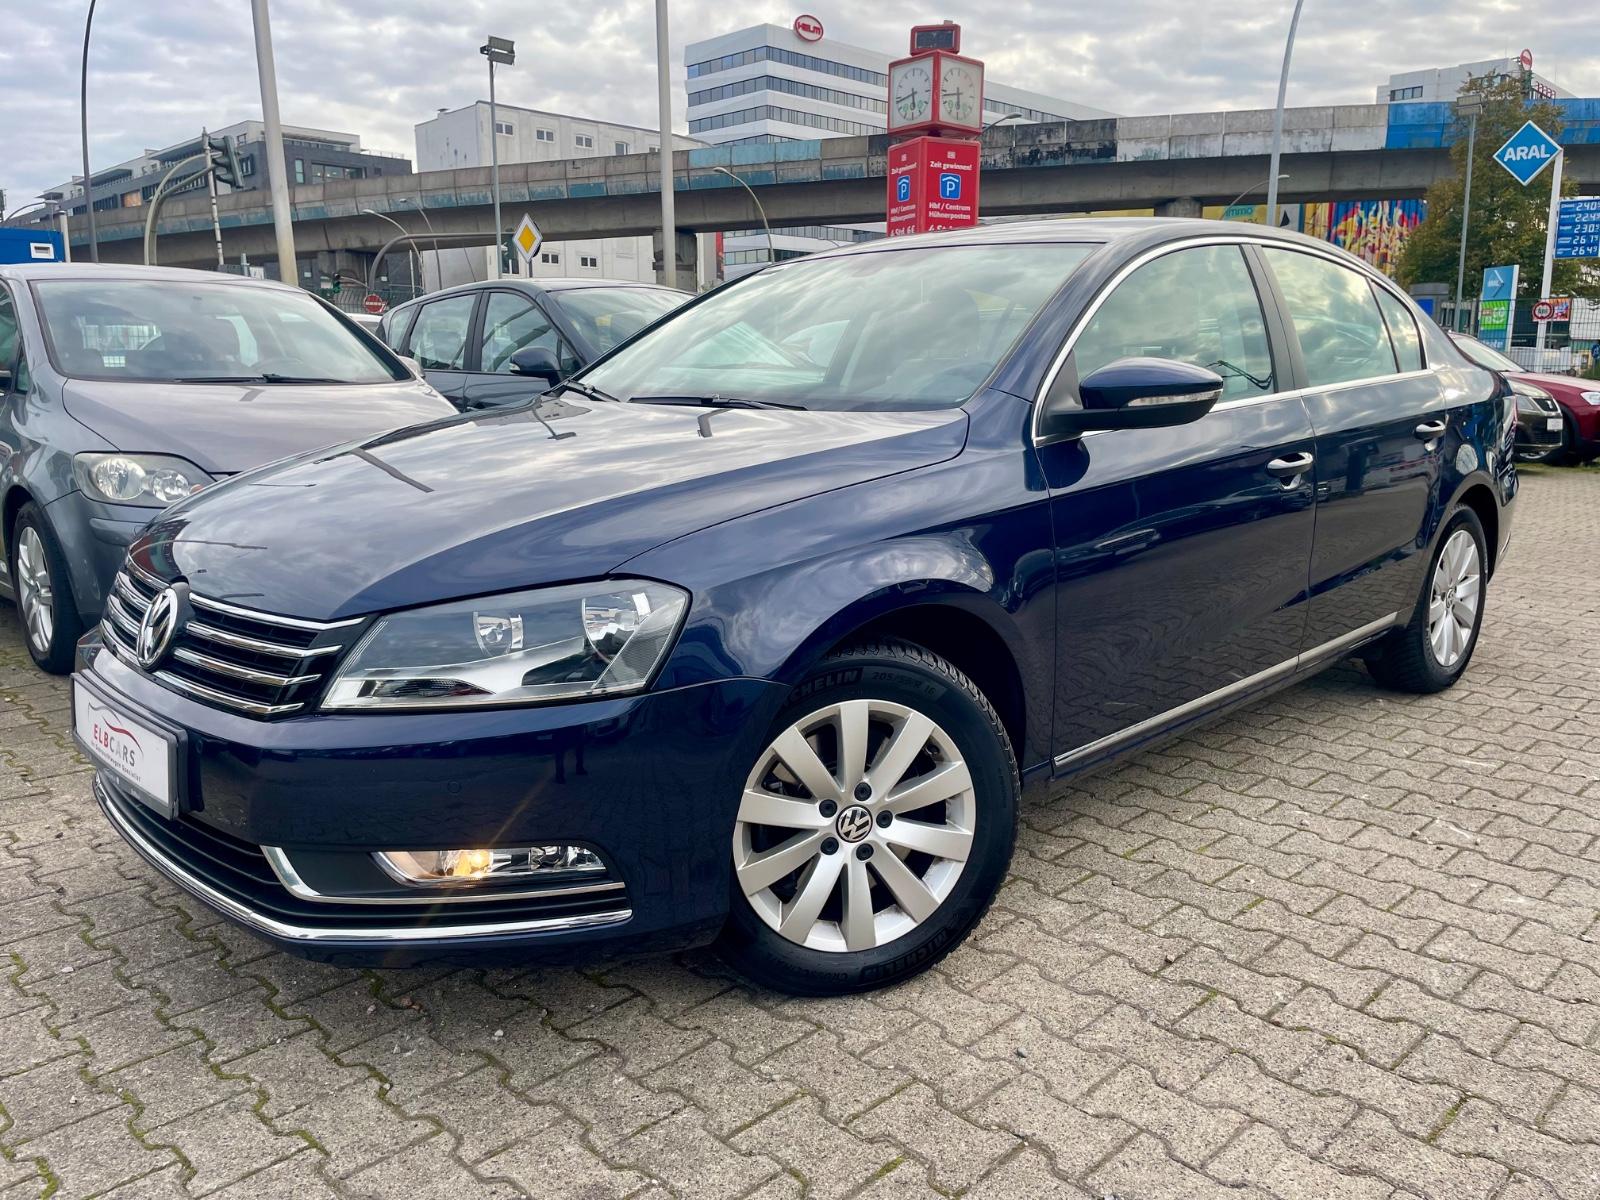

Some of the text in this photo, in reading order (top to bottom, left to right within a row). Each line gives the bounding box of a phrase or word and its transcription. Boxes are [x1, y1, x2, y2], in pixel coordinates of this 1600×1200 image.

[1503, 143, 1551, 162] ARAL
[930, 161, 973, 171] Zeit gewinnen!
[900, 183, 907, 199] P
[946, 181, 956, 197] P
[929, 202, 940, 210] Hbf
[945, 202, 971, 212] Centrum
[929, 211, 971, 221] Hühnerposten
